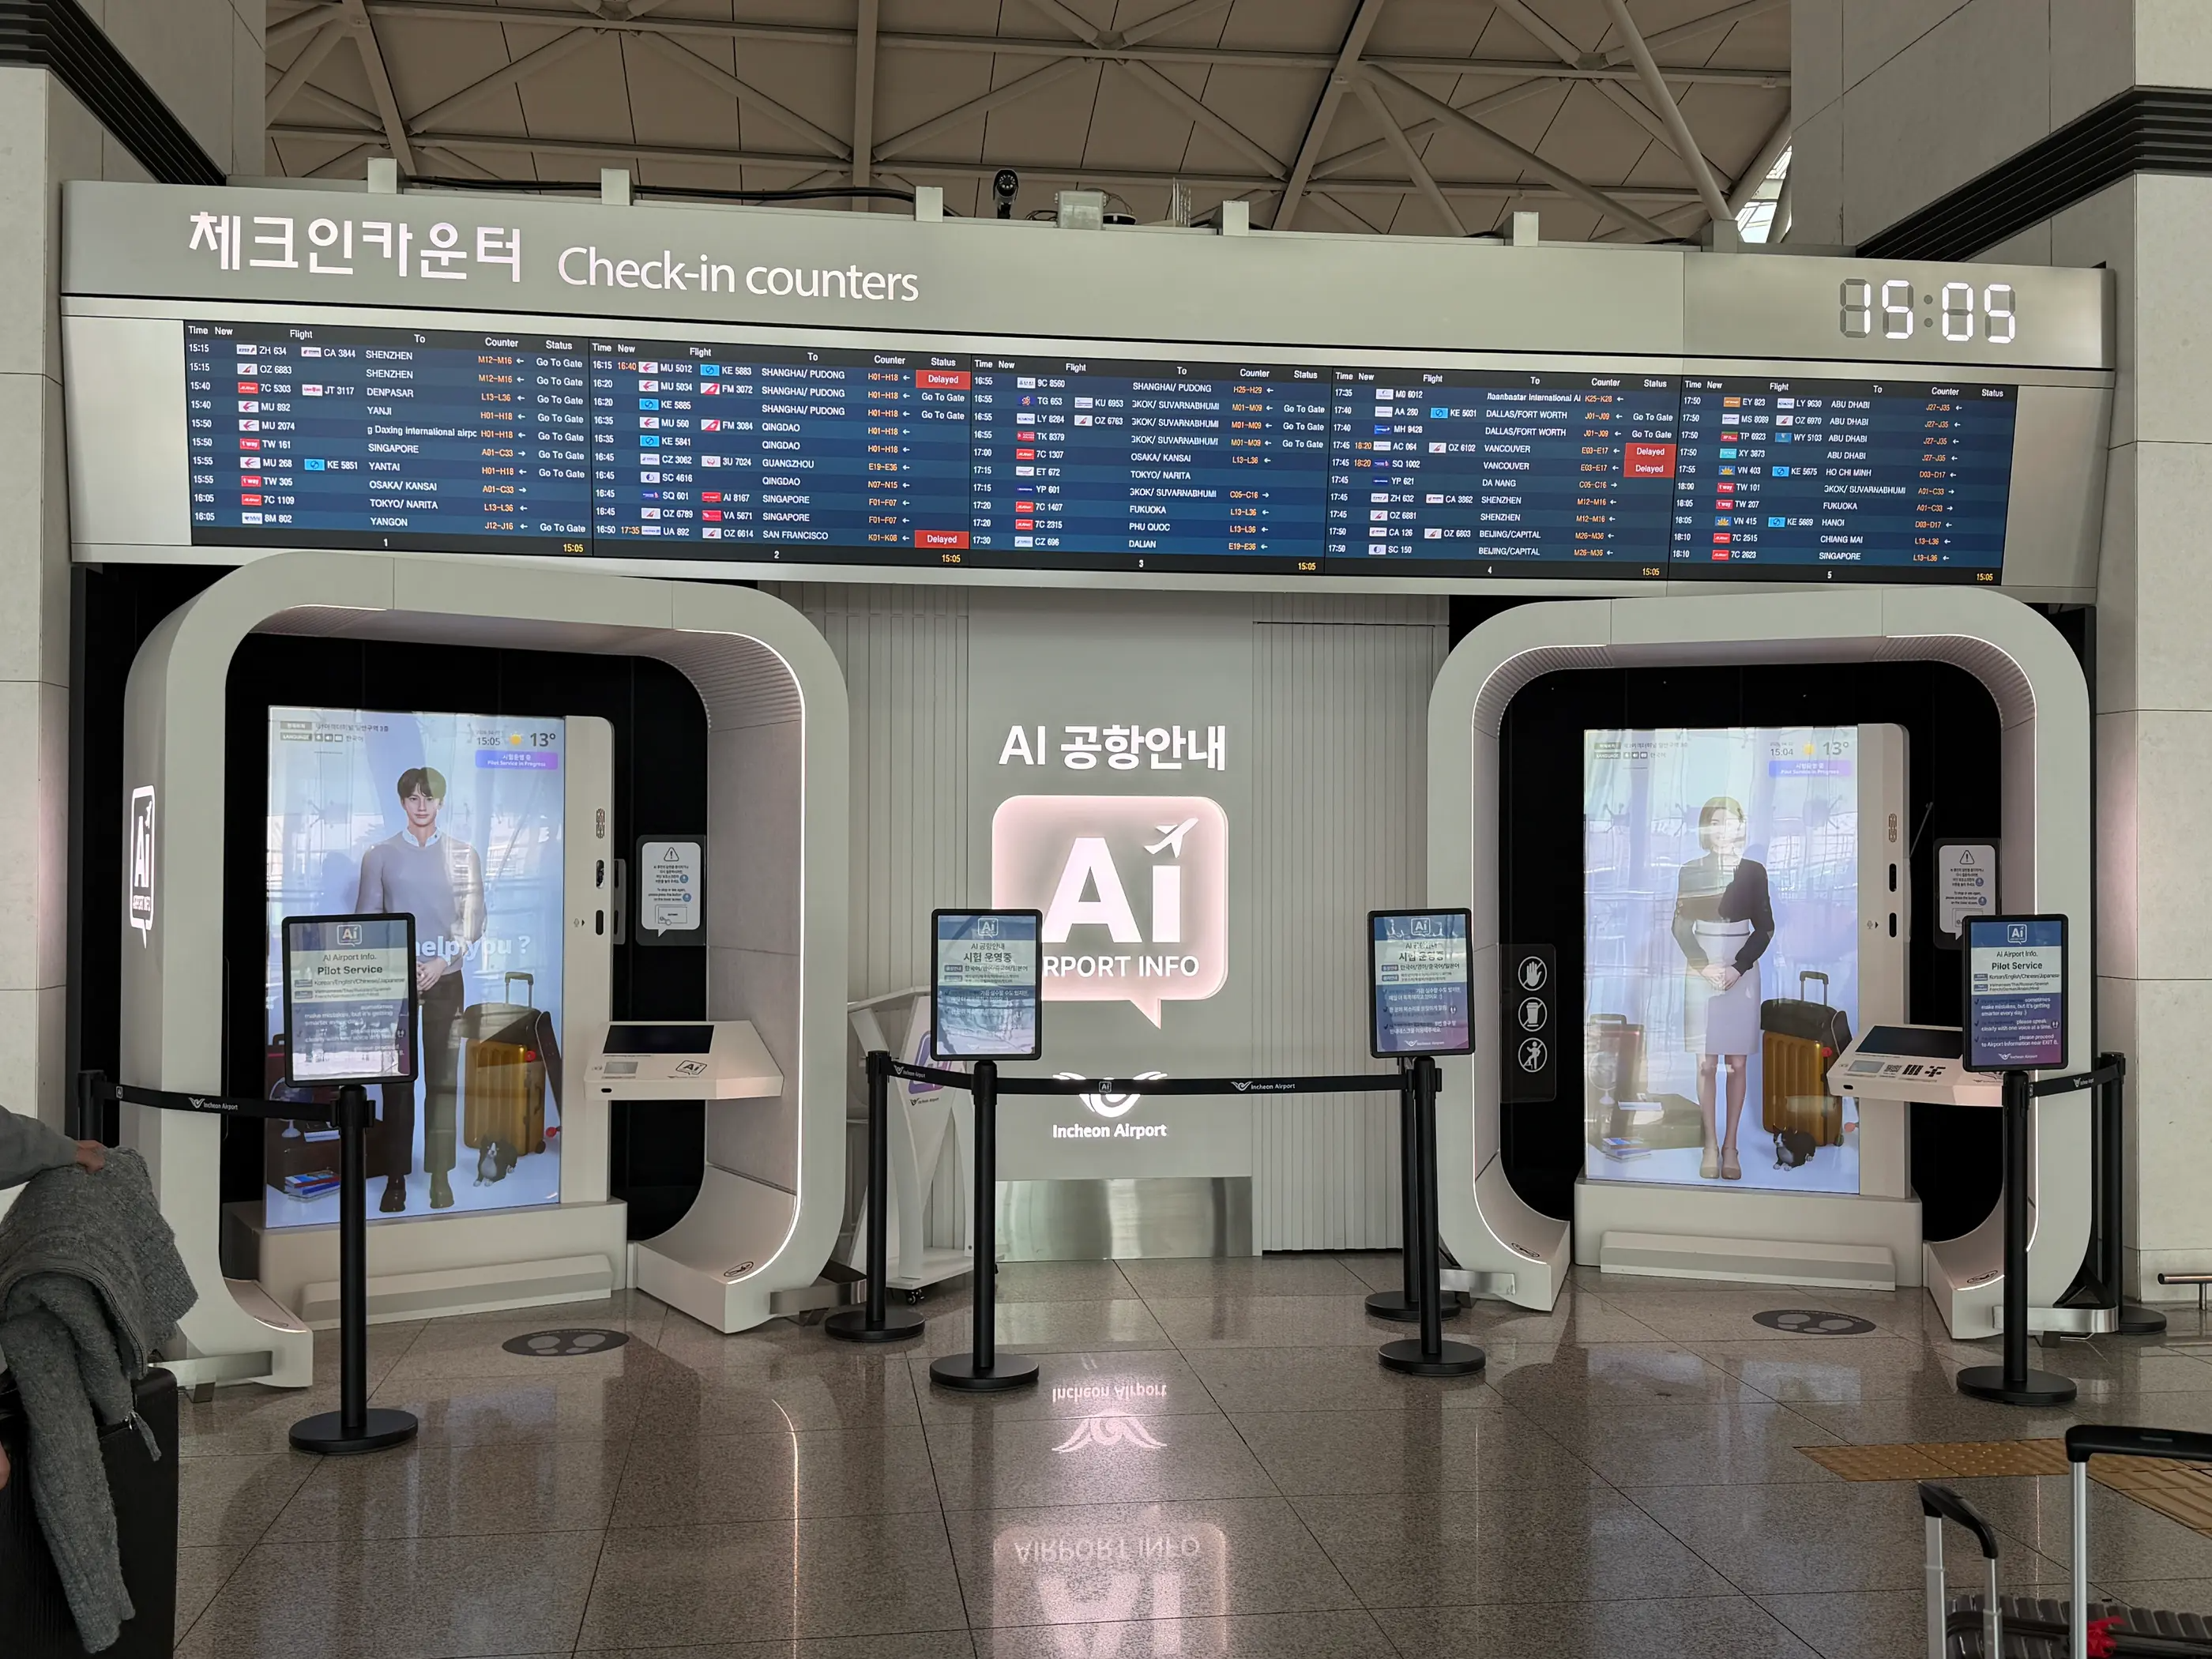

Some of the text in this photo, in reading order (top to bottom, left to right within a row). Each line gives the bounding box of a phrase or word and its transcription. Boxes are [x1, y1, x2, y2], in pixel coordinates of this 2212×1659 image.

[190, 211, 521, 284] 체크인카운터
[559, 246, 918, 302] Check-in counters
[1864, 280, 2015, 344] 15:05
[190, 344, 209, 352] 15:15
[366, 350, 412, 359] SHENZHEN
[660, 363, 673, 372] MU
[675, 364, 692, 373] 5012
[735, 367, 751, 375] 5883
[762, 368, 807, 378] SHANGHAI/
[810, 370, 845, 379] PUDONG
[927, 373, 958, 387] Delayed
[1424, 374, 1443, 384] Flight
[1637, 447, 1665, 457] Delayed
[563, 544, 583, 552] 15:05
[530, 733, 555, 747] 13°
[999, 724, 1226, 771] AI 공항안내
[1823, 742, 1849, 755] 13°
[982, 920, 995, 931] Ai
[1415, 920, 1427, 931] Ai
[342, 927, 359, 939] Ai
[2012, 927, 2024, 938] Ai
[466, 940, 511, 961] you
[964, 953, 1012, 962] 시험 운영중
[318, 965, 382, 975] Pilot Service
[1043, 956, 1199, 977] RPORT INFO
[1053, 1123, 1167, 1139] Incheon Airport
